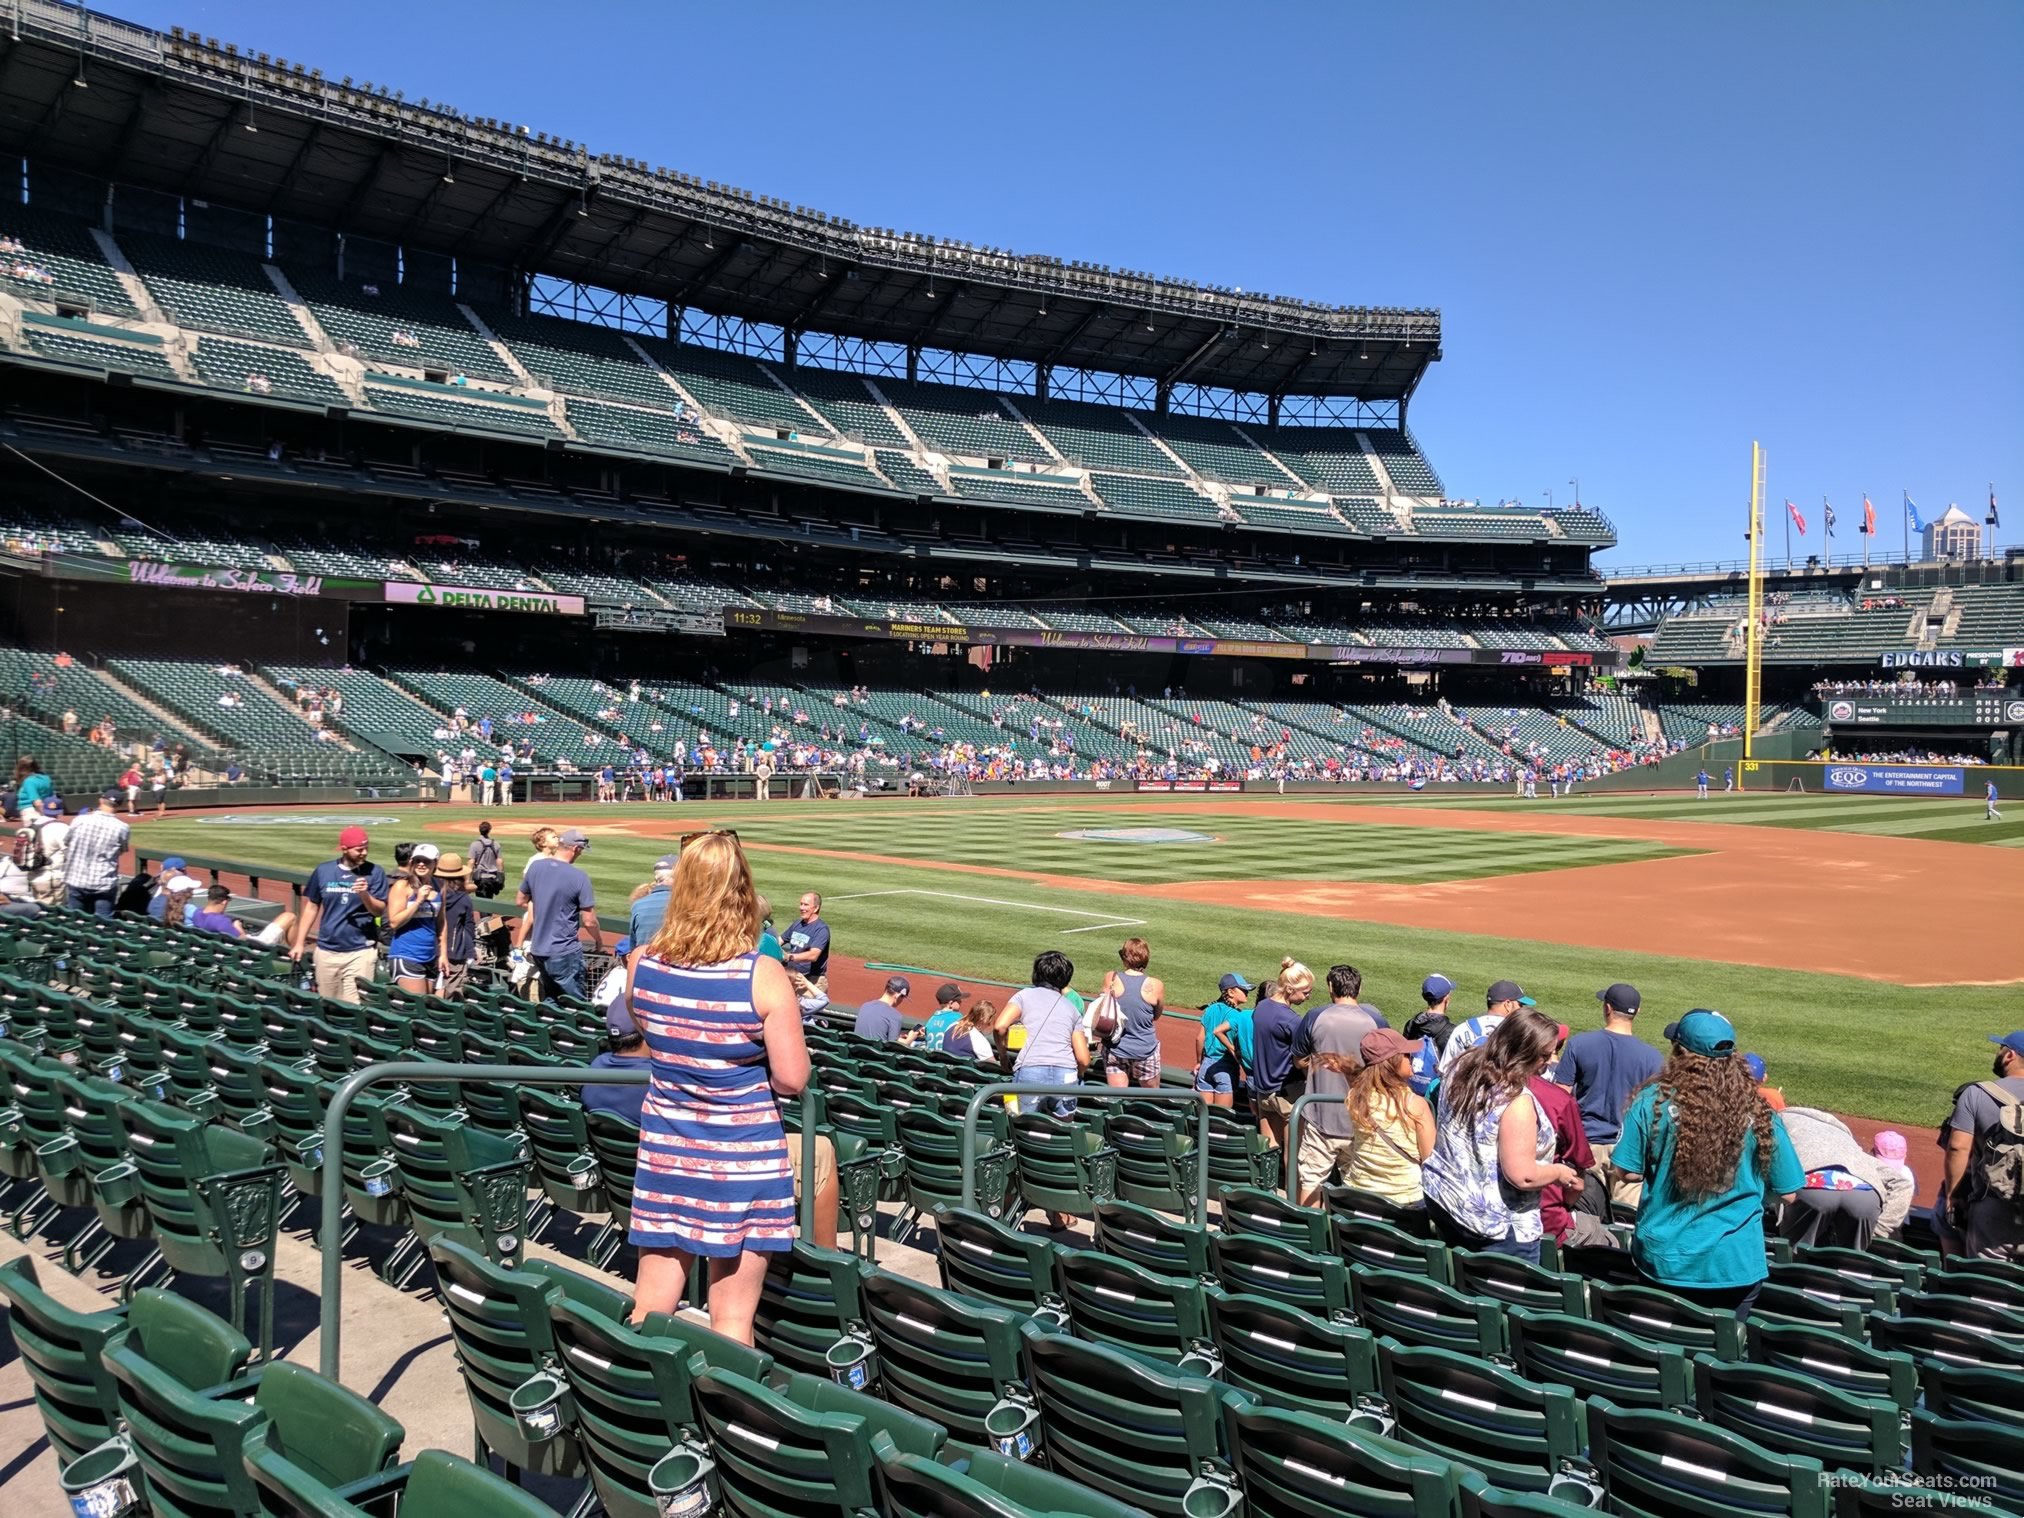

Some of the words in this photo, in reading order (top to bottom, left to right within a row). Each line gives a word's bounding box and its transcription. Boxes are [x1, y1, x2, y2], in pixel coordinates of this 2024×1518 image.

[128, 561, 198, 586] Welcome
[203, 574, 216, 588] to
[219, 569, 274, 592] Safeco
[275, 574, 323, 595] Field
[442, 591, 492, 609] DELTA
[497, 595, 560, 613] DENTAL
[734, 612, 761, 625] 11:32
[891, 624, 922, 633] MARINERS
[924, 626, 940, 634] TEAM
[942, 627, 967, 635] STORES
[893, 631, 920, 639] LOCATIONS
[921, 632, 935, 640] OPEN
[1040, 632, 1078, 646] Welcome
[1081, 638, 1089, 647] to
[1090, 635, 1121, 649] Safeco
[1121, 636, 1148, 650] Field
[1380, 648, 1412, 662] Safeco
[1413, 649, 1440, 663] Field
[1501, 652, 1526, 663] 710
[1543, 653, 1592, 665] ESPN
[1882, 651, 1961, 668] EDGARS
[1744, 762, 1759, 771] 331
[1833, 771, 1866, 784] EQC
[1885, 772, 1932, 780] ENTERTAINMENT
[505, 1239, 511, 1247] 8
[250, 1255, 257, 1264] 9
